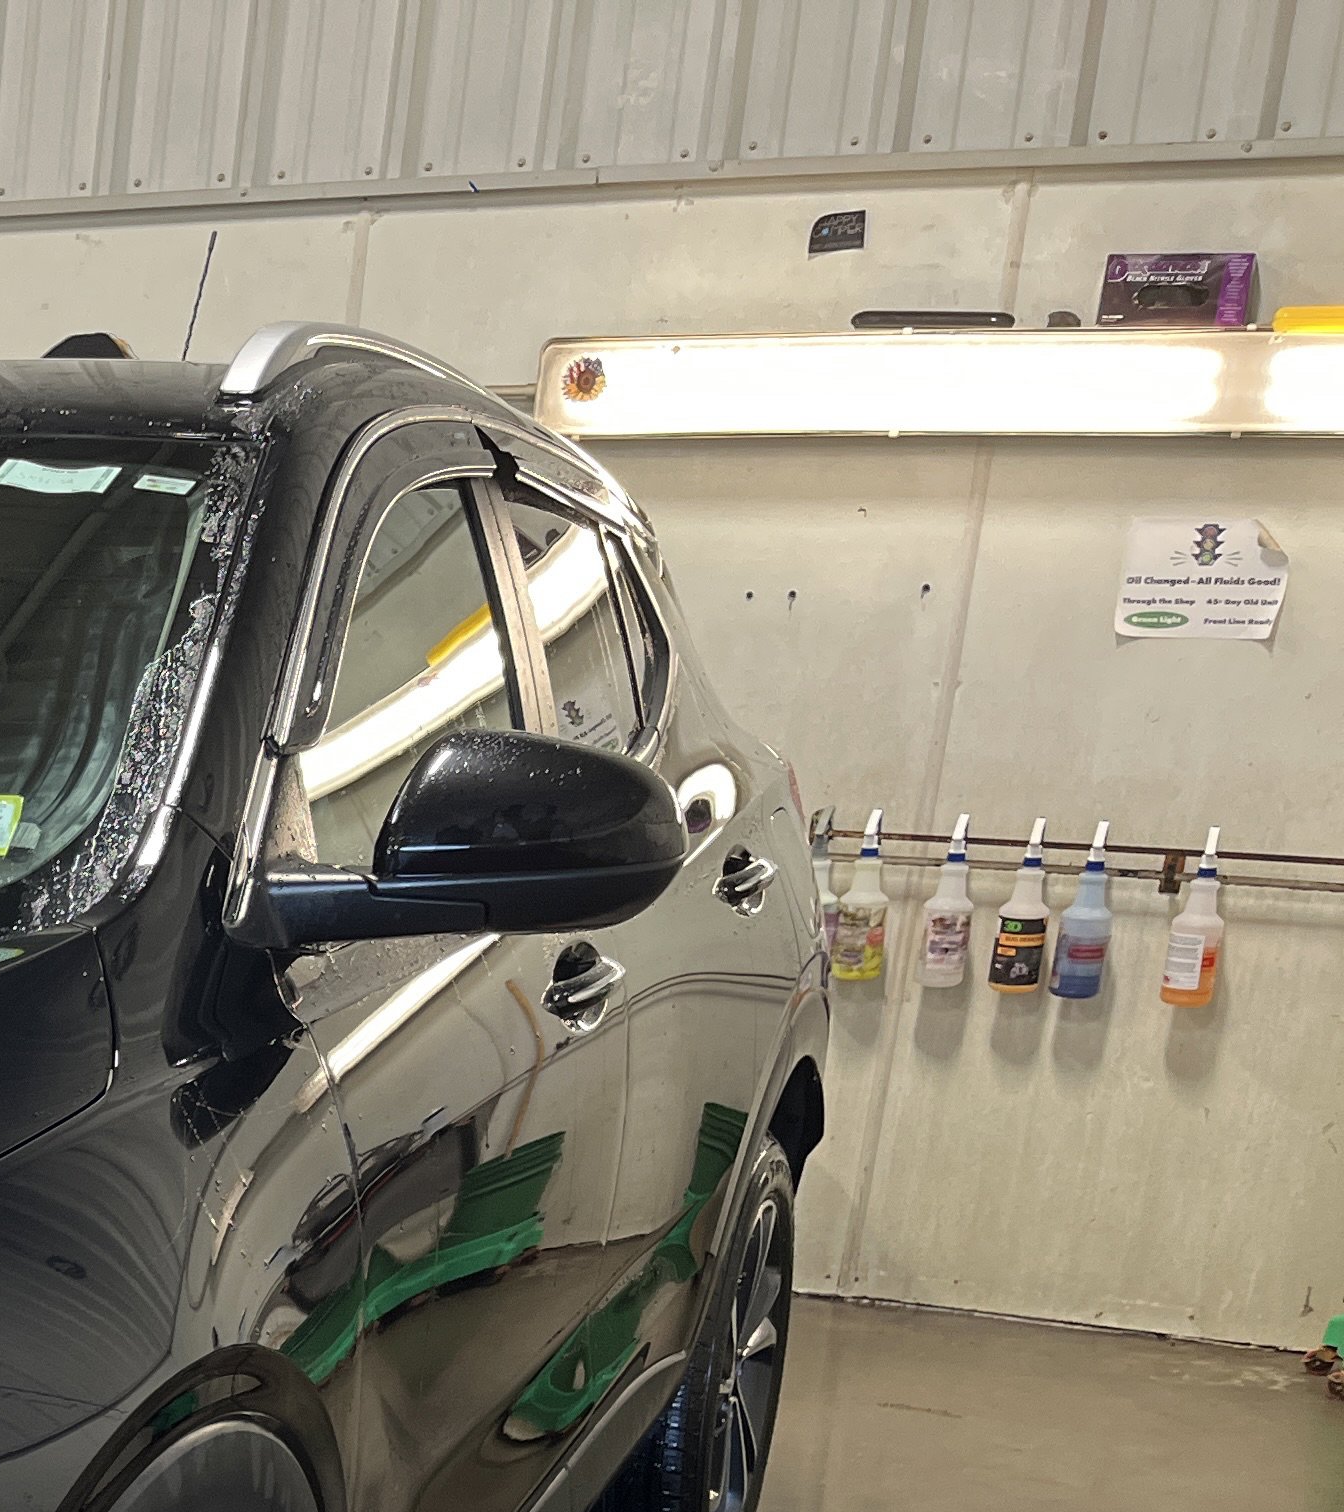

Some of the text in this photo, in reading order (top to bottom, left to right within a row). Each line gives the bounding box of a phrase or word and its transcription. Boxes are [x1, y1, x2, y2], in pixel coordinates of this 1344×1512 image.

[1126, 576, 1142, 585] Oil
[1144, 576, 1190, 587] Changed
[1197, 576, 1212, 585] All
[1214, 576, 1245, 586] Fluids
[1247, 577, 1281, 586] Good!
[1123, 597, 1157, 606] Through
[1243, 598, 1259, 606] Old
[1160, 615, 1182, 625] Light
